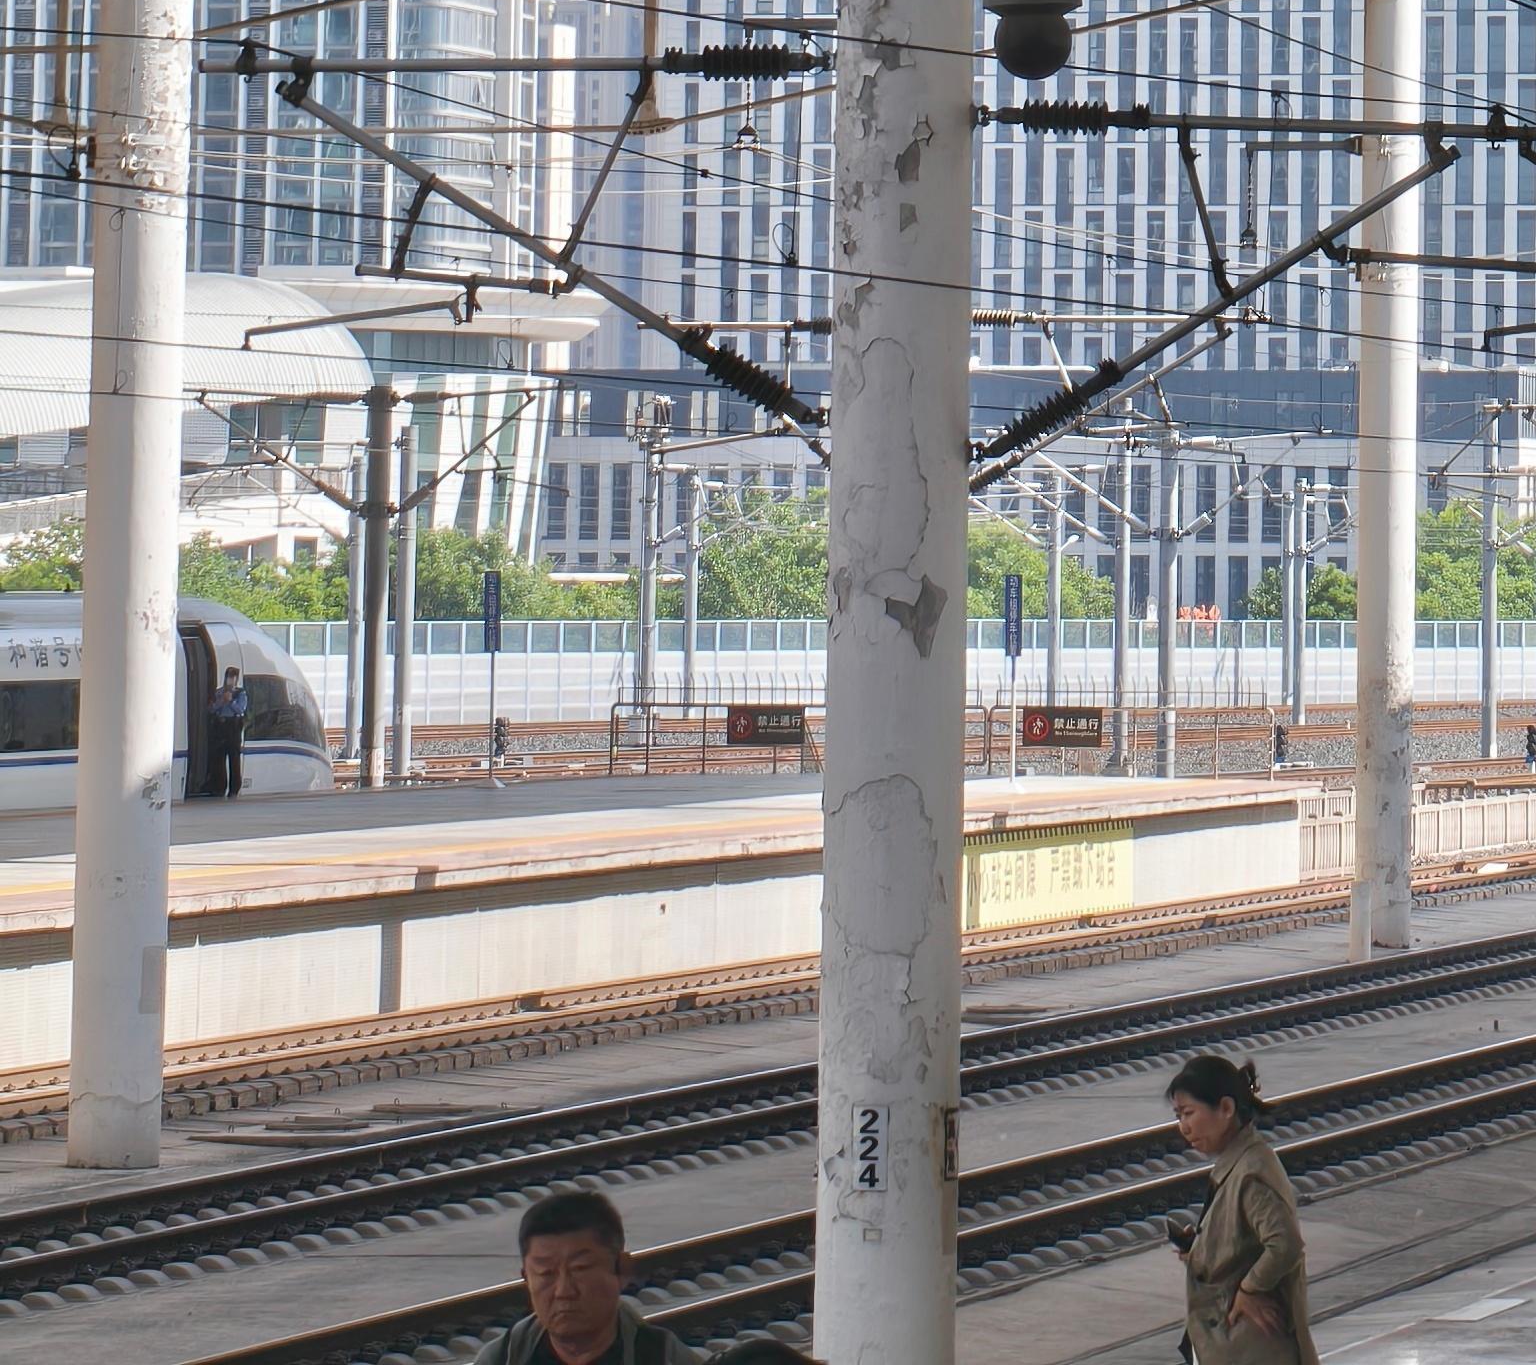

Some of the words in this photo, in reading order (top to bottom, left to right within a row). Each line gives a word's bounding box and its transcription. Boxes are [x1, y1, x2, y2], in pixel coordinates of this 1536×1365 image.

[1054, 718, 1099, 730] 禁止通行
[858, 1108, 880, 1188] 224
